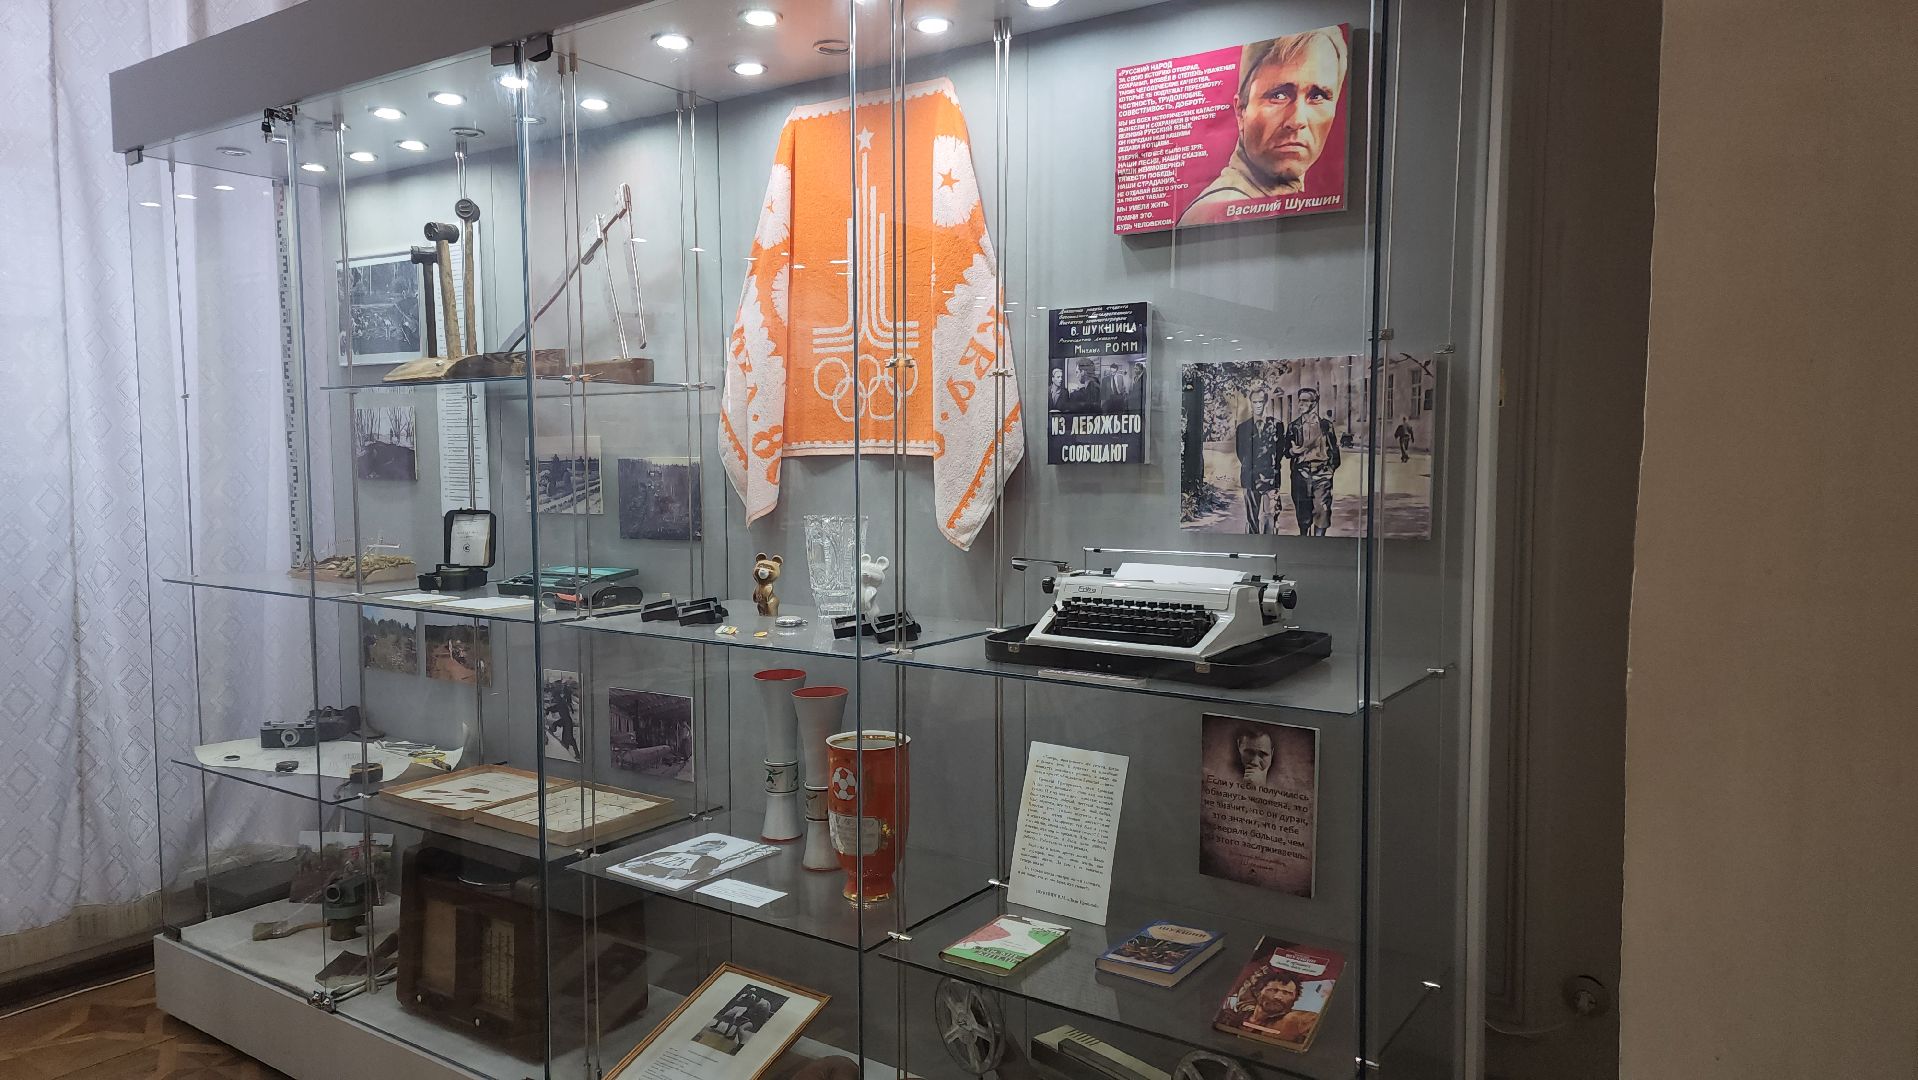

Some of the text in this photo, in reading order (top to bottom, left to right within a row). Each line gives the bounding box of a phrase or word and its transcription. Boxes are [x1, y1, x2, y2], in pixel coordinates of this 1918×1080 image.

[1151, 61, 1172, 70] НАРОД
[1174, 122, 1193, 130] ЯЗЫК
[1162, 154, 1181, 163] НАШИ
[1226, 195, 1340, 216] Василий Шукшин
[1082, 322, 1137, 336] ШУКШИНА
[1105, 341, 1138, 353] РОММ
[1052, 414, 1141, 436] ИЗ ЛЕБЯЖЬЕГО
[1062, 444, 1128, 464] СООБЩАЮТ
[1207, 774, 1227, 786] Если
[1236, 782, 1256, 791] тебя
[1267, 811, 1277, 819] он
[1280, 826, 1299, 834] тебе
